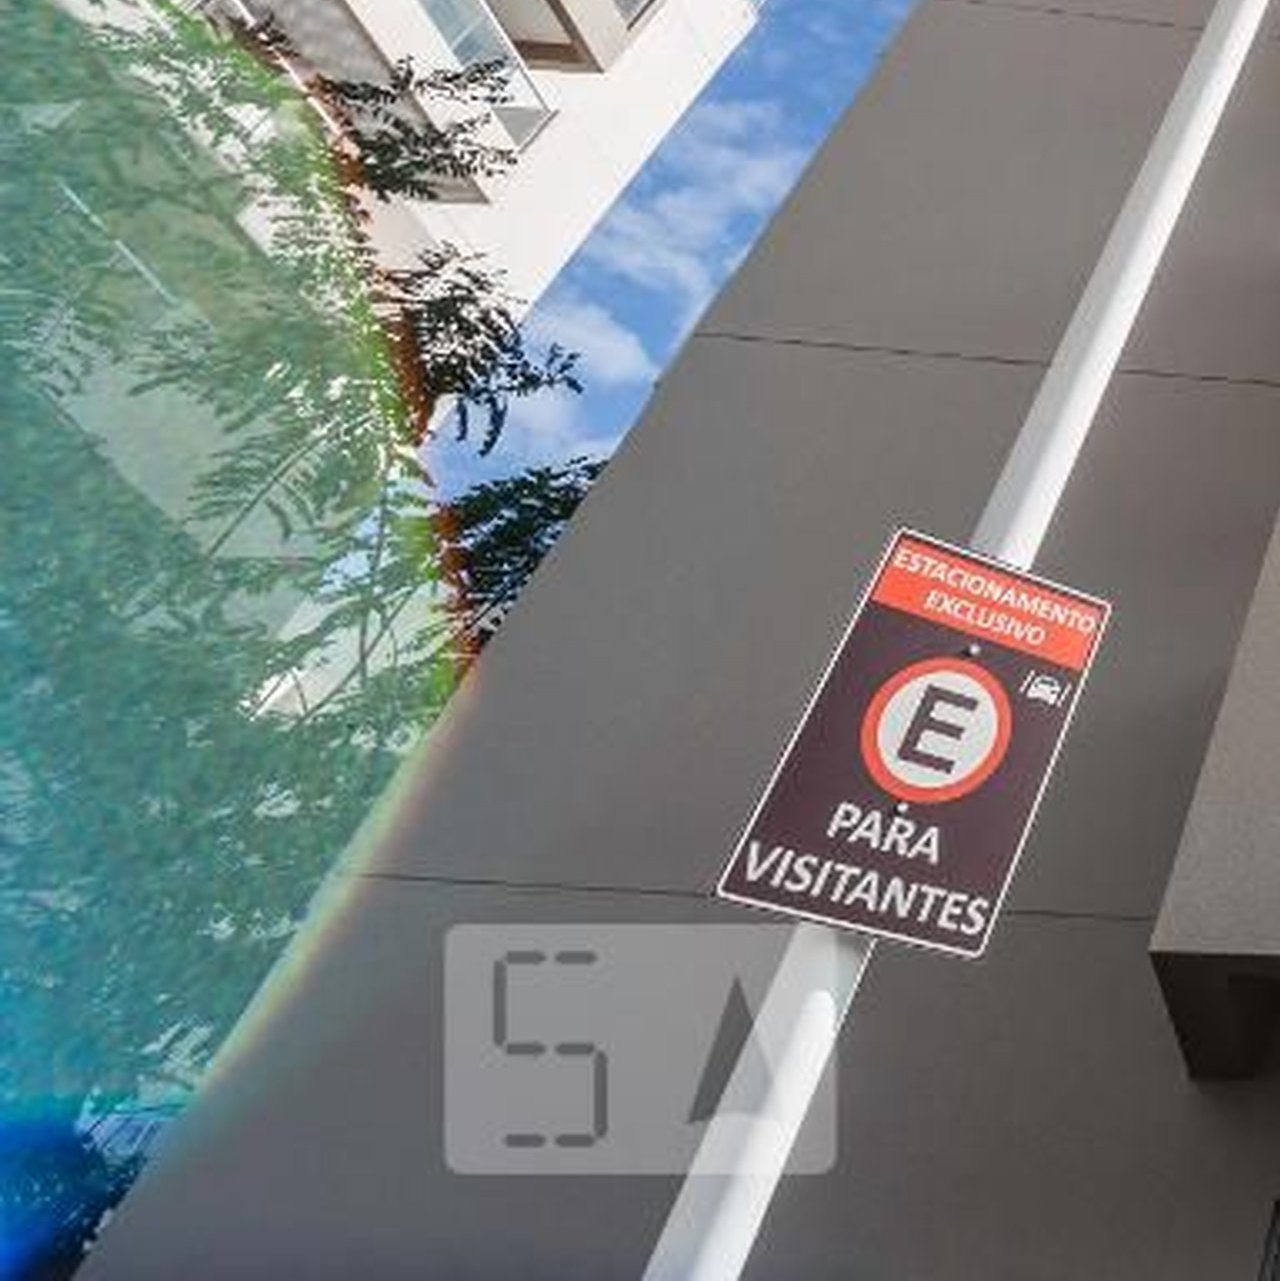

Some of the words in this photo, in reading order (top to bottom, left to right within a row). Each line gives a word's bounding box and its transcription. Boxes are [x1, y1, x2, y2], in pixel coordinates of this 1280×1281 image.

[894, 550, 1098, 634] ESTACIONAMENTO
[924, 591, 1046, 645] EXCLUSIVO
[898, 685, 979, 774] E
[826, 802, 940, 865] PARA
[745, 840, 989, 936] VISITANTES
